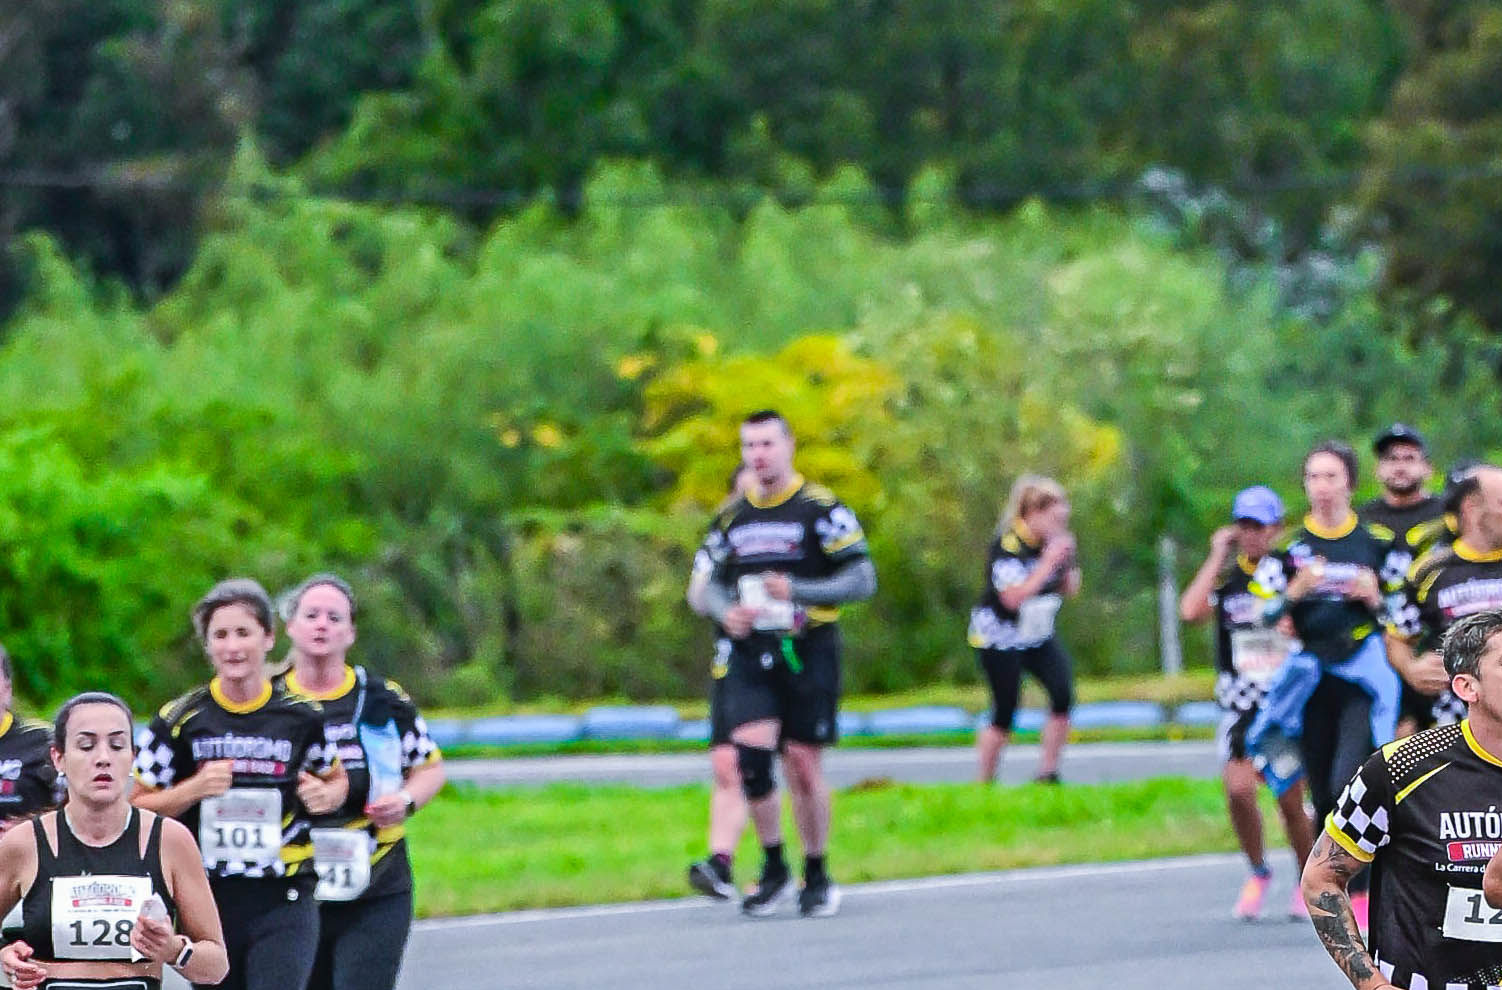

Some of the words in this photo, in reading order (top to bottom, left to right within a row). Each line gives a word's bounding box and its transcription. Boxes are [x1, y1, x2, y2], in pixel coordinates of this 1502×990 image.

[215, 828, 265, 848] 101
[1462, 843, 1502, 859] RUNN
[1435, 862, 1446, 872] La
[1447, 863, 1479, 873] Carrera
[69, 919, 134, 947] 128
